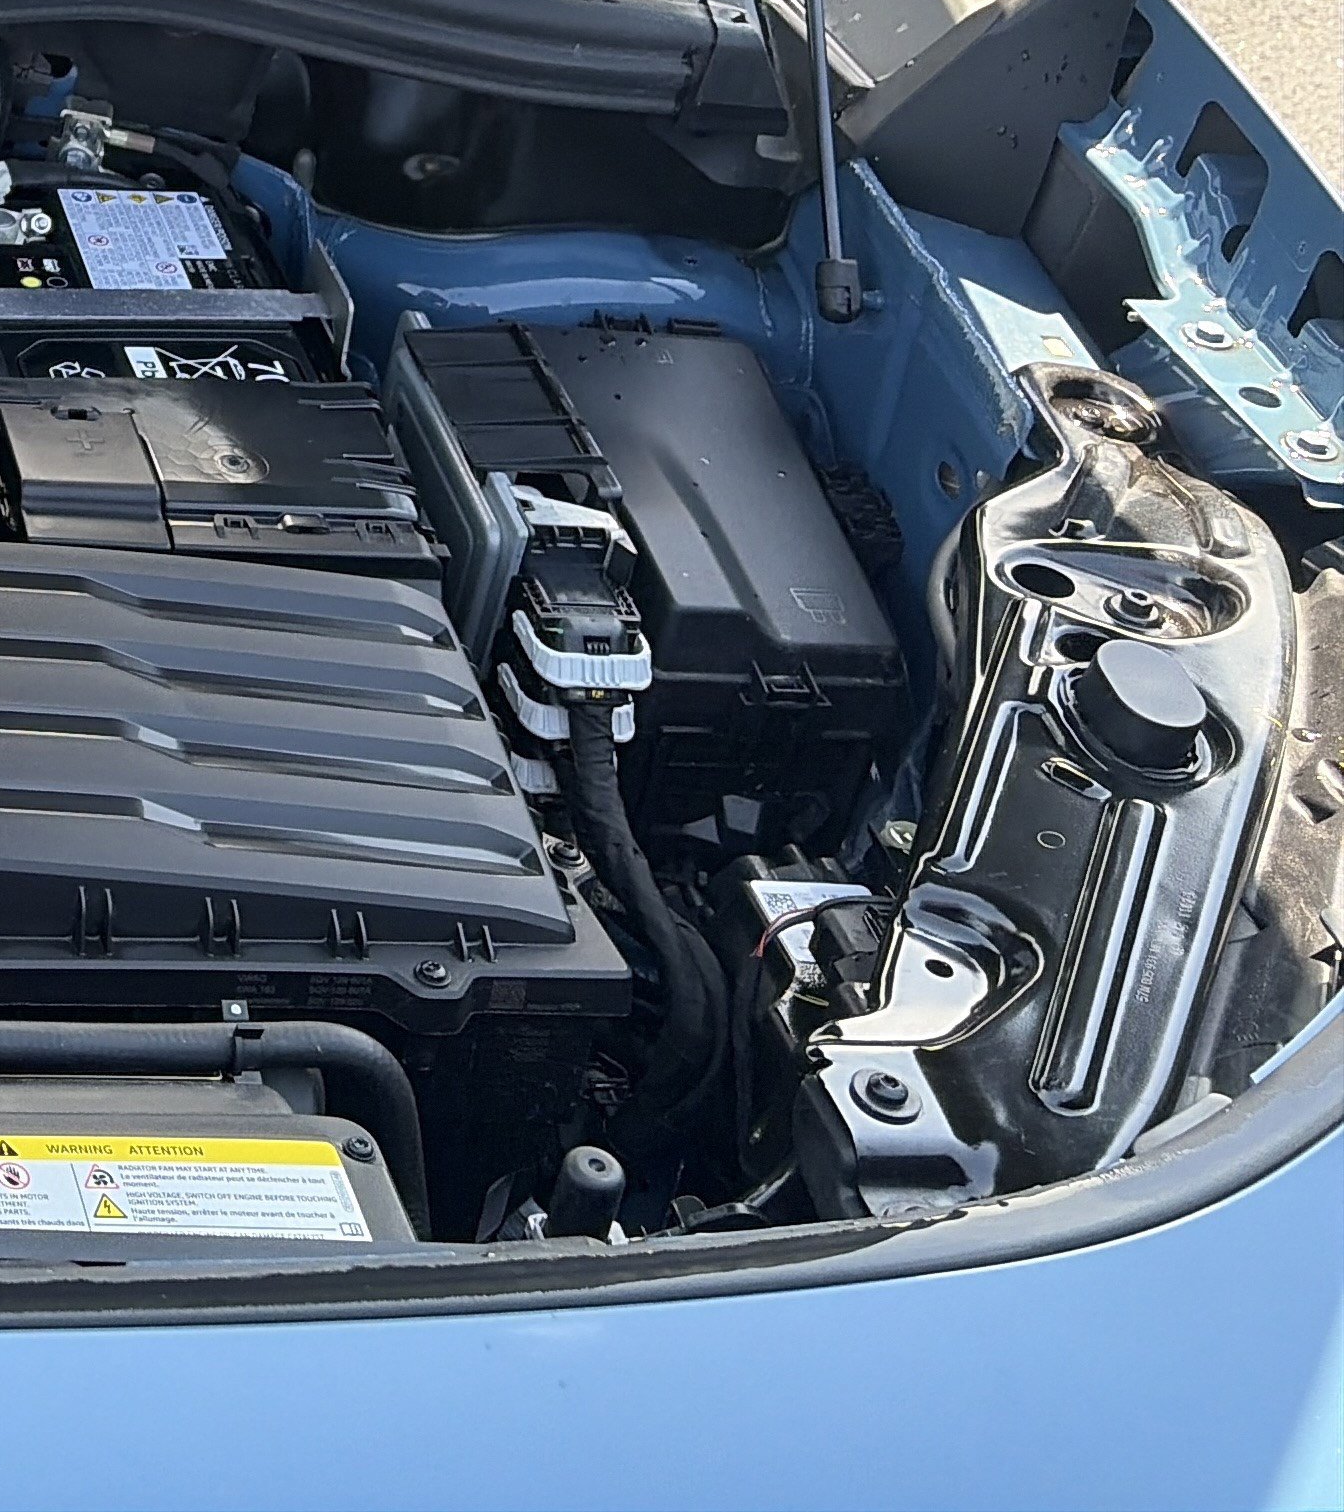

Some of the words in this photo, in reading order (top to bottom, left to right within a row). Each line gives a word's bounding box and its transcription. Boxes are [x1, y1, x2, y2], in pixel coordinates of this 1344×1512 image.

[46, 1144, 113, 1155] WARNING
[129, 1145, 204, 1156] ATTENTION
[188, 1174, 224, 1182] radiateur
[257, 1175, 300, 1184] déclencher
[308, 1177, 326, 1185] tout
[128, 1198, 165, 1206] IGNITION
[296, 1195, 338, 1203] TOUCHING
[131, 1207, 157, 1215] Haute
[191, 1208, 219, 1216] arrêter
[229, 1209, 259, 1217] moteur
[296, 1211, 328, 1219] toucher
[21, 1218, 37, 1226] très
[38, 1218, 65, 1227] chauds
[66, 1219, 85, 1227] dans
